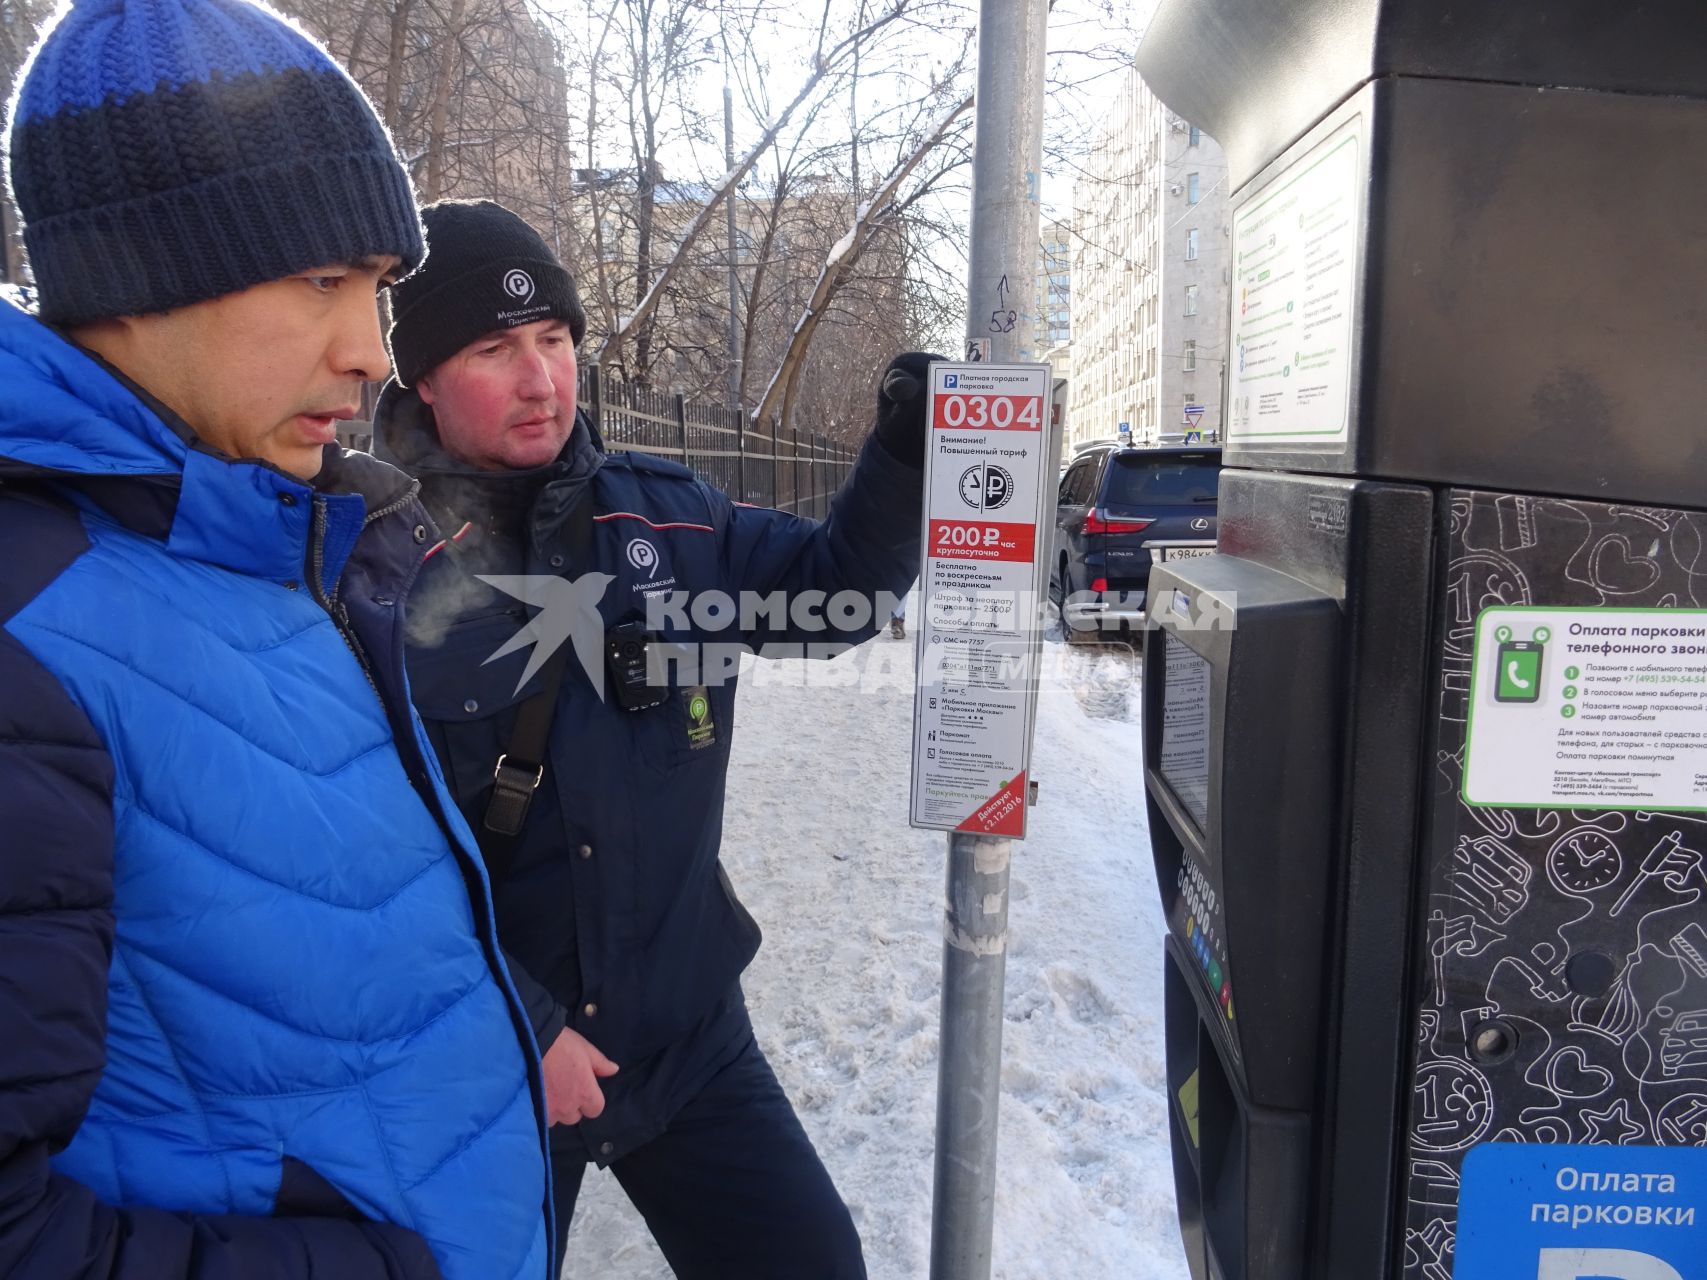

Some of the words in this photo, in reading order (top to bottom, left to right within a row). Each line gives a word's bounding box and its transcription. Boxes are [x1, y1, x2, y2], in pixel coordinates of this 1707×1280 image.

[497, 304, 551, 320] Московский
[989, 310, 1017, 333] 58
[946, 376, 956, 387] P
[944, 395, 1040, 428] 0304
[940, 435, 986, 444] Внимание!
[940, 446, 998, 455] Повышенный
[1000, 448, 1027, 458] тариф
[1000, 541, 1016, 549] час
[936, 547, 1000, 557] круглосуточно
[936, 562, 977, 571] Бесплатно
[947, 573, 1002, 581] воскресеньям
[632, 577, 676, 592] Московский
[942, 581, 991, 589] праздникам
[643, 587, 673, 599] Паркинг
[934, 593, 962, 603] Штраф
[975, 598, 1014, 606] неоплату
[934, 603, 972, 611] парковки
[933, 617, 968, 625] Способы
[970, 620, 1000, 628] оплаты
[1569, 623, 1627, 636] Оплата
[1631, 626, 1706, 640] парковки
[1567, 641, 1667, 656] телефонного
[1671, 645, 1707, 654] звон
[1636, 664, 1682, 672] мобильного
[1597, 676, 1622, 684] номер
[1636, 675, 1659, 684] (495)
[1661, 675, 1706, 683] 539-54-54
[1660, 689, 1698, 699] выберите
[942, 698, 977, 706] Мобильное
[978, 702, 1016, 710] приложение
[942, 705, 975, 713] «Парковки
[1582, 702, 1620, 710] Назовите
[1622, 704, 1648, 712] номер
[1650, 703, 1702, 712] парковочной
[1581, 714, 1606, 722] номер
[940, 730, 970, 738] Паркомат
[1557, 728, 1573, 737] Для
[1602, 730, 1662, 738] пользователей
[1557, 740, 1598, 748] телефона,
[939, 749, 970, 757] Голосовая
[1556, 751, 1587, 760] Оплата
[925, 787, 969, 798] Паркуйтесь
[977, 790, 1012, 821] Действует
[988, 796, 1022, 828] 2.12.2016
[1555, 1167, 1676, 1193] Оплата
[1530, 1203, 1695, 1229] парковки
